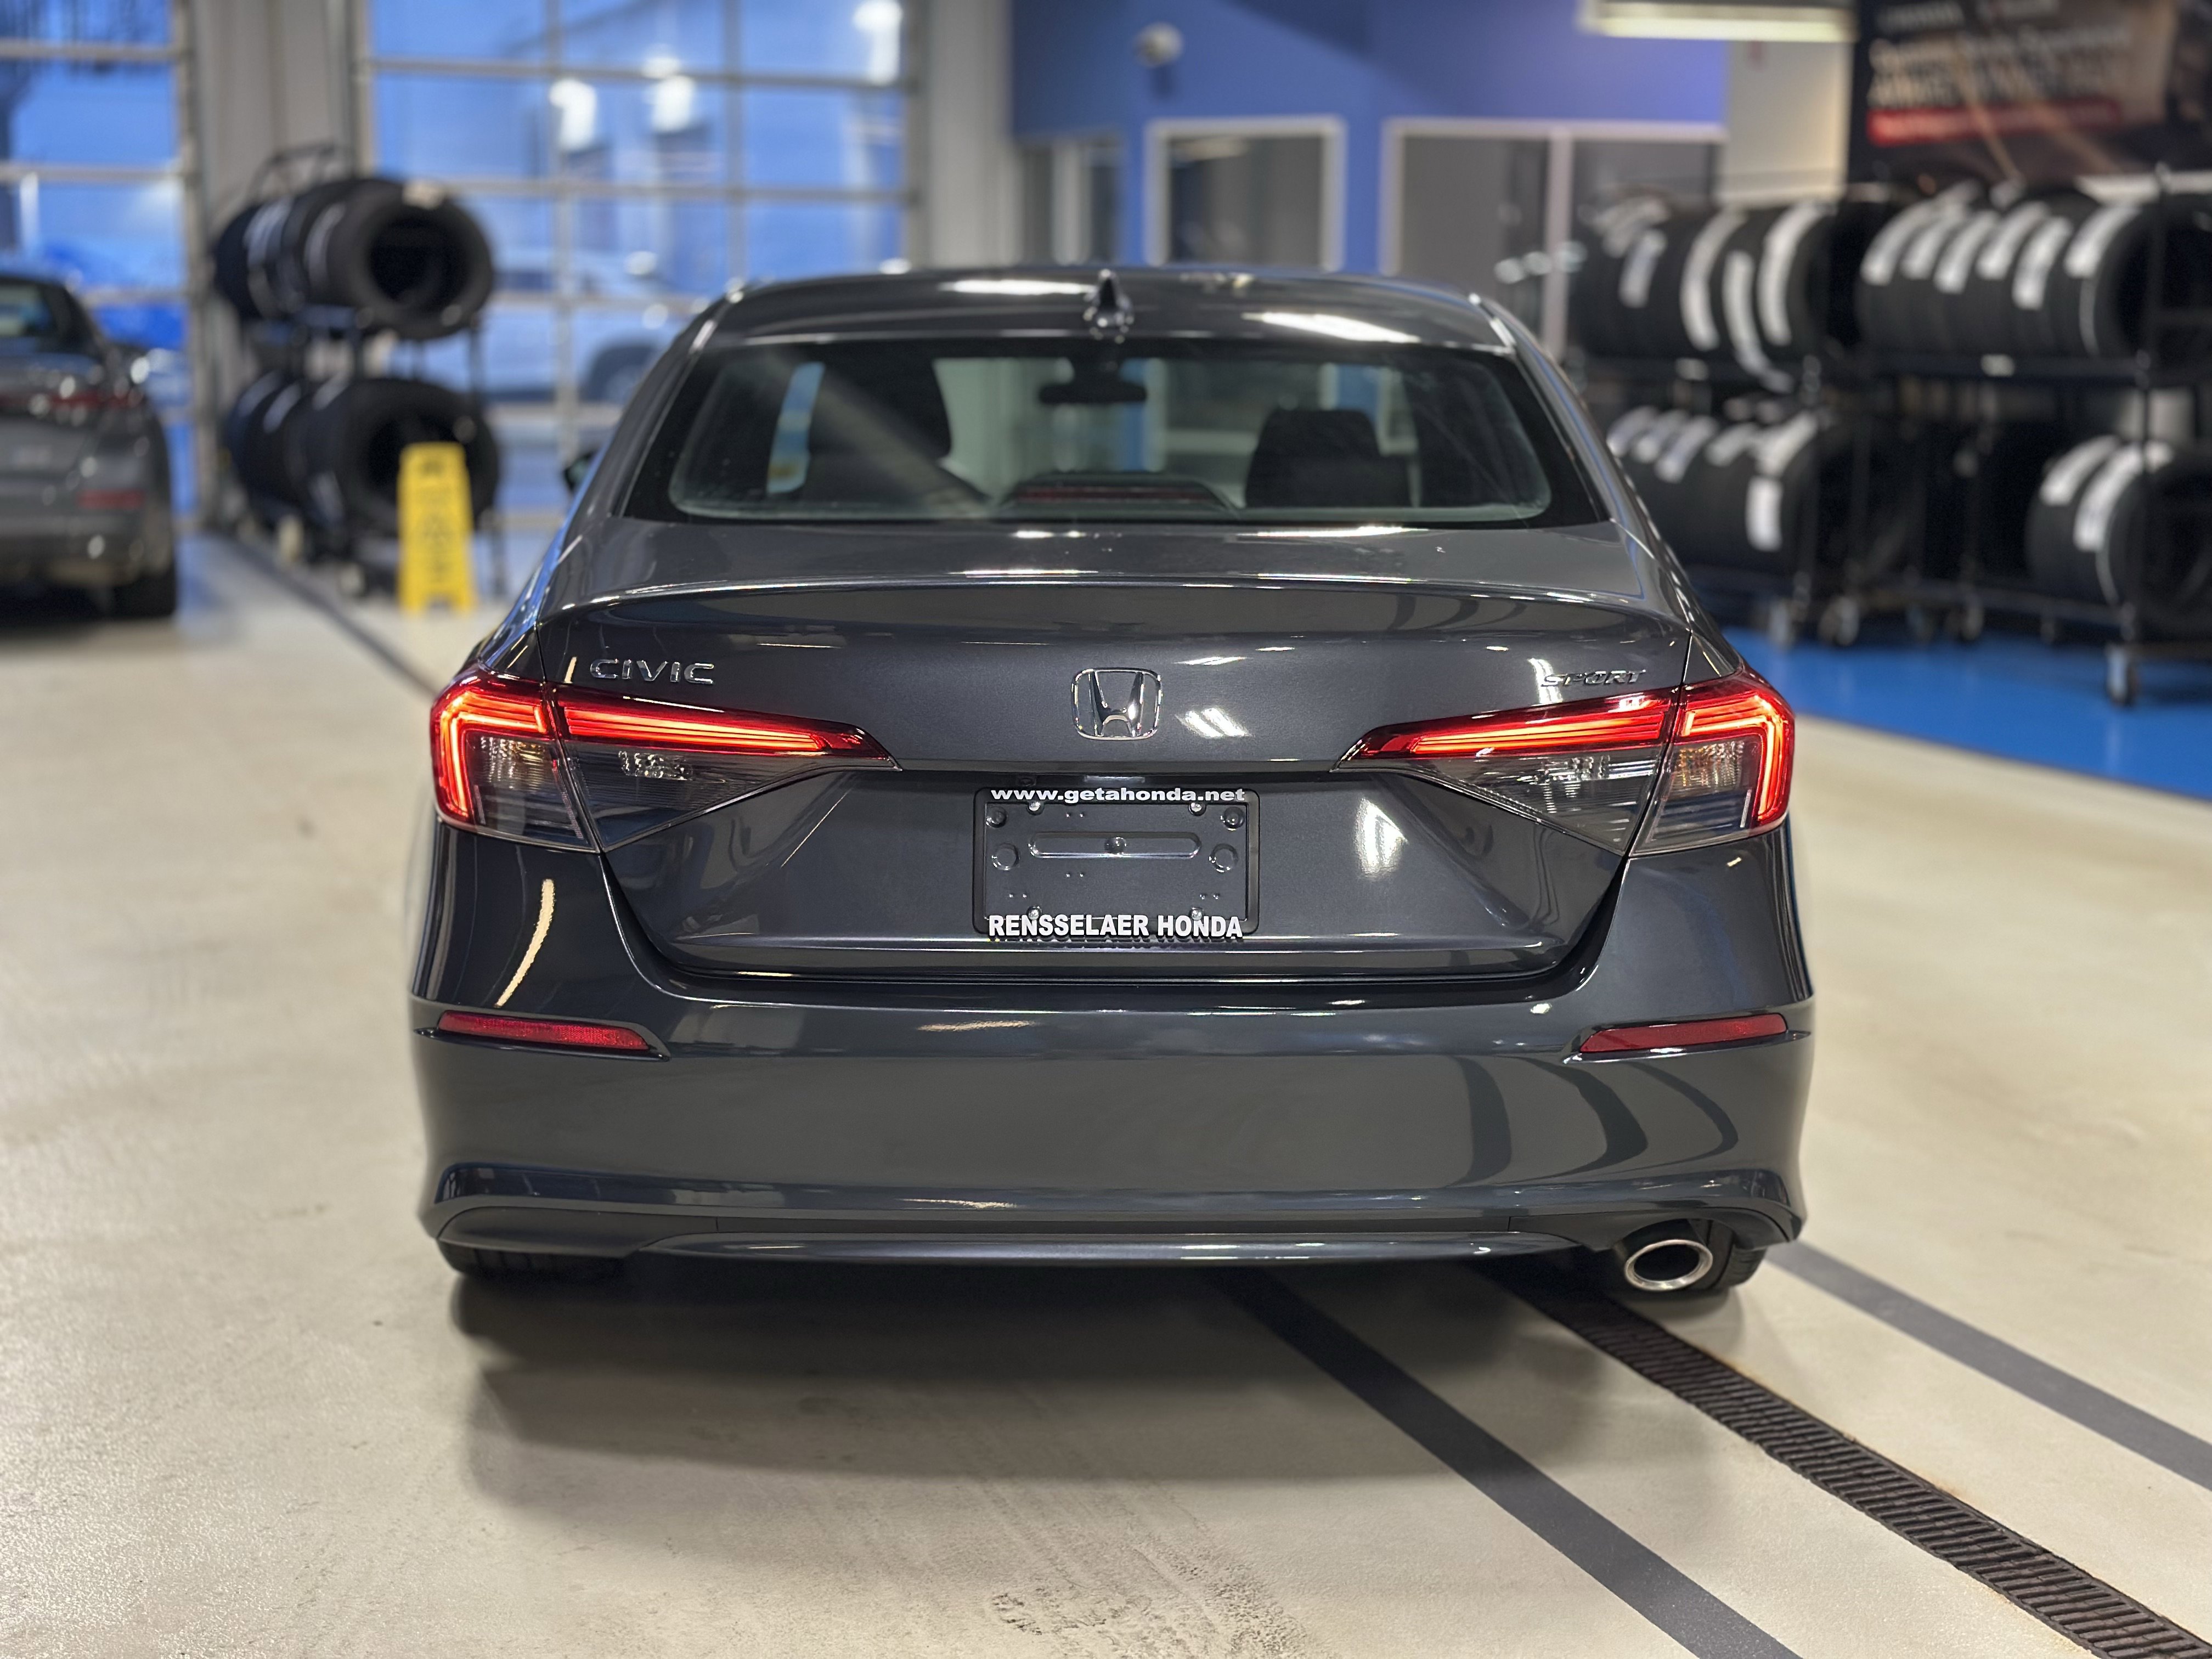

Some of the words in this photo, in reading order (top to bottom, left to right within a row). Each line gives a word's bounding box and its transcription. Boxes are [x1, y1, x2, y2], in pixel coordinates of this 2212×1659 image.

[590, 658, 714, 685] CIVIC
[1541, 669, 1646, 687] SPORT
[991, 787, 1245, 803] www.getahonda.net
[989, 915, 1149, 936] RENSSELAER
[1158, 916, 1243, 937] HONDA
